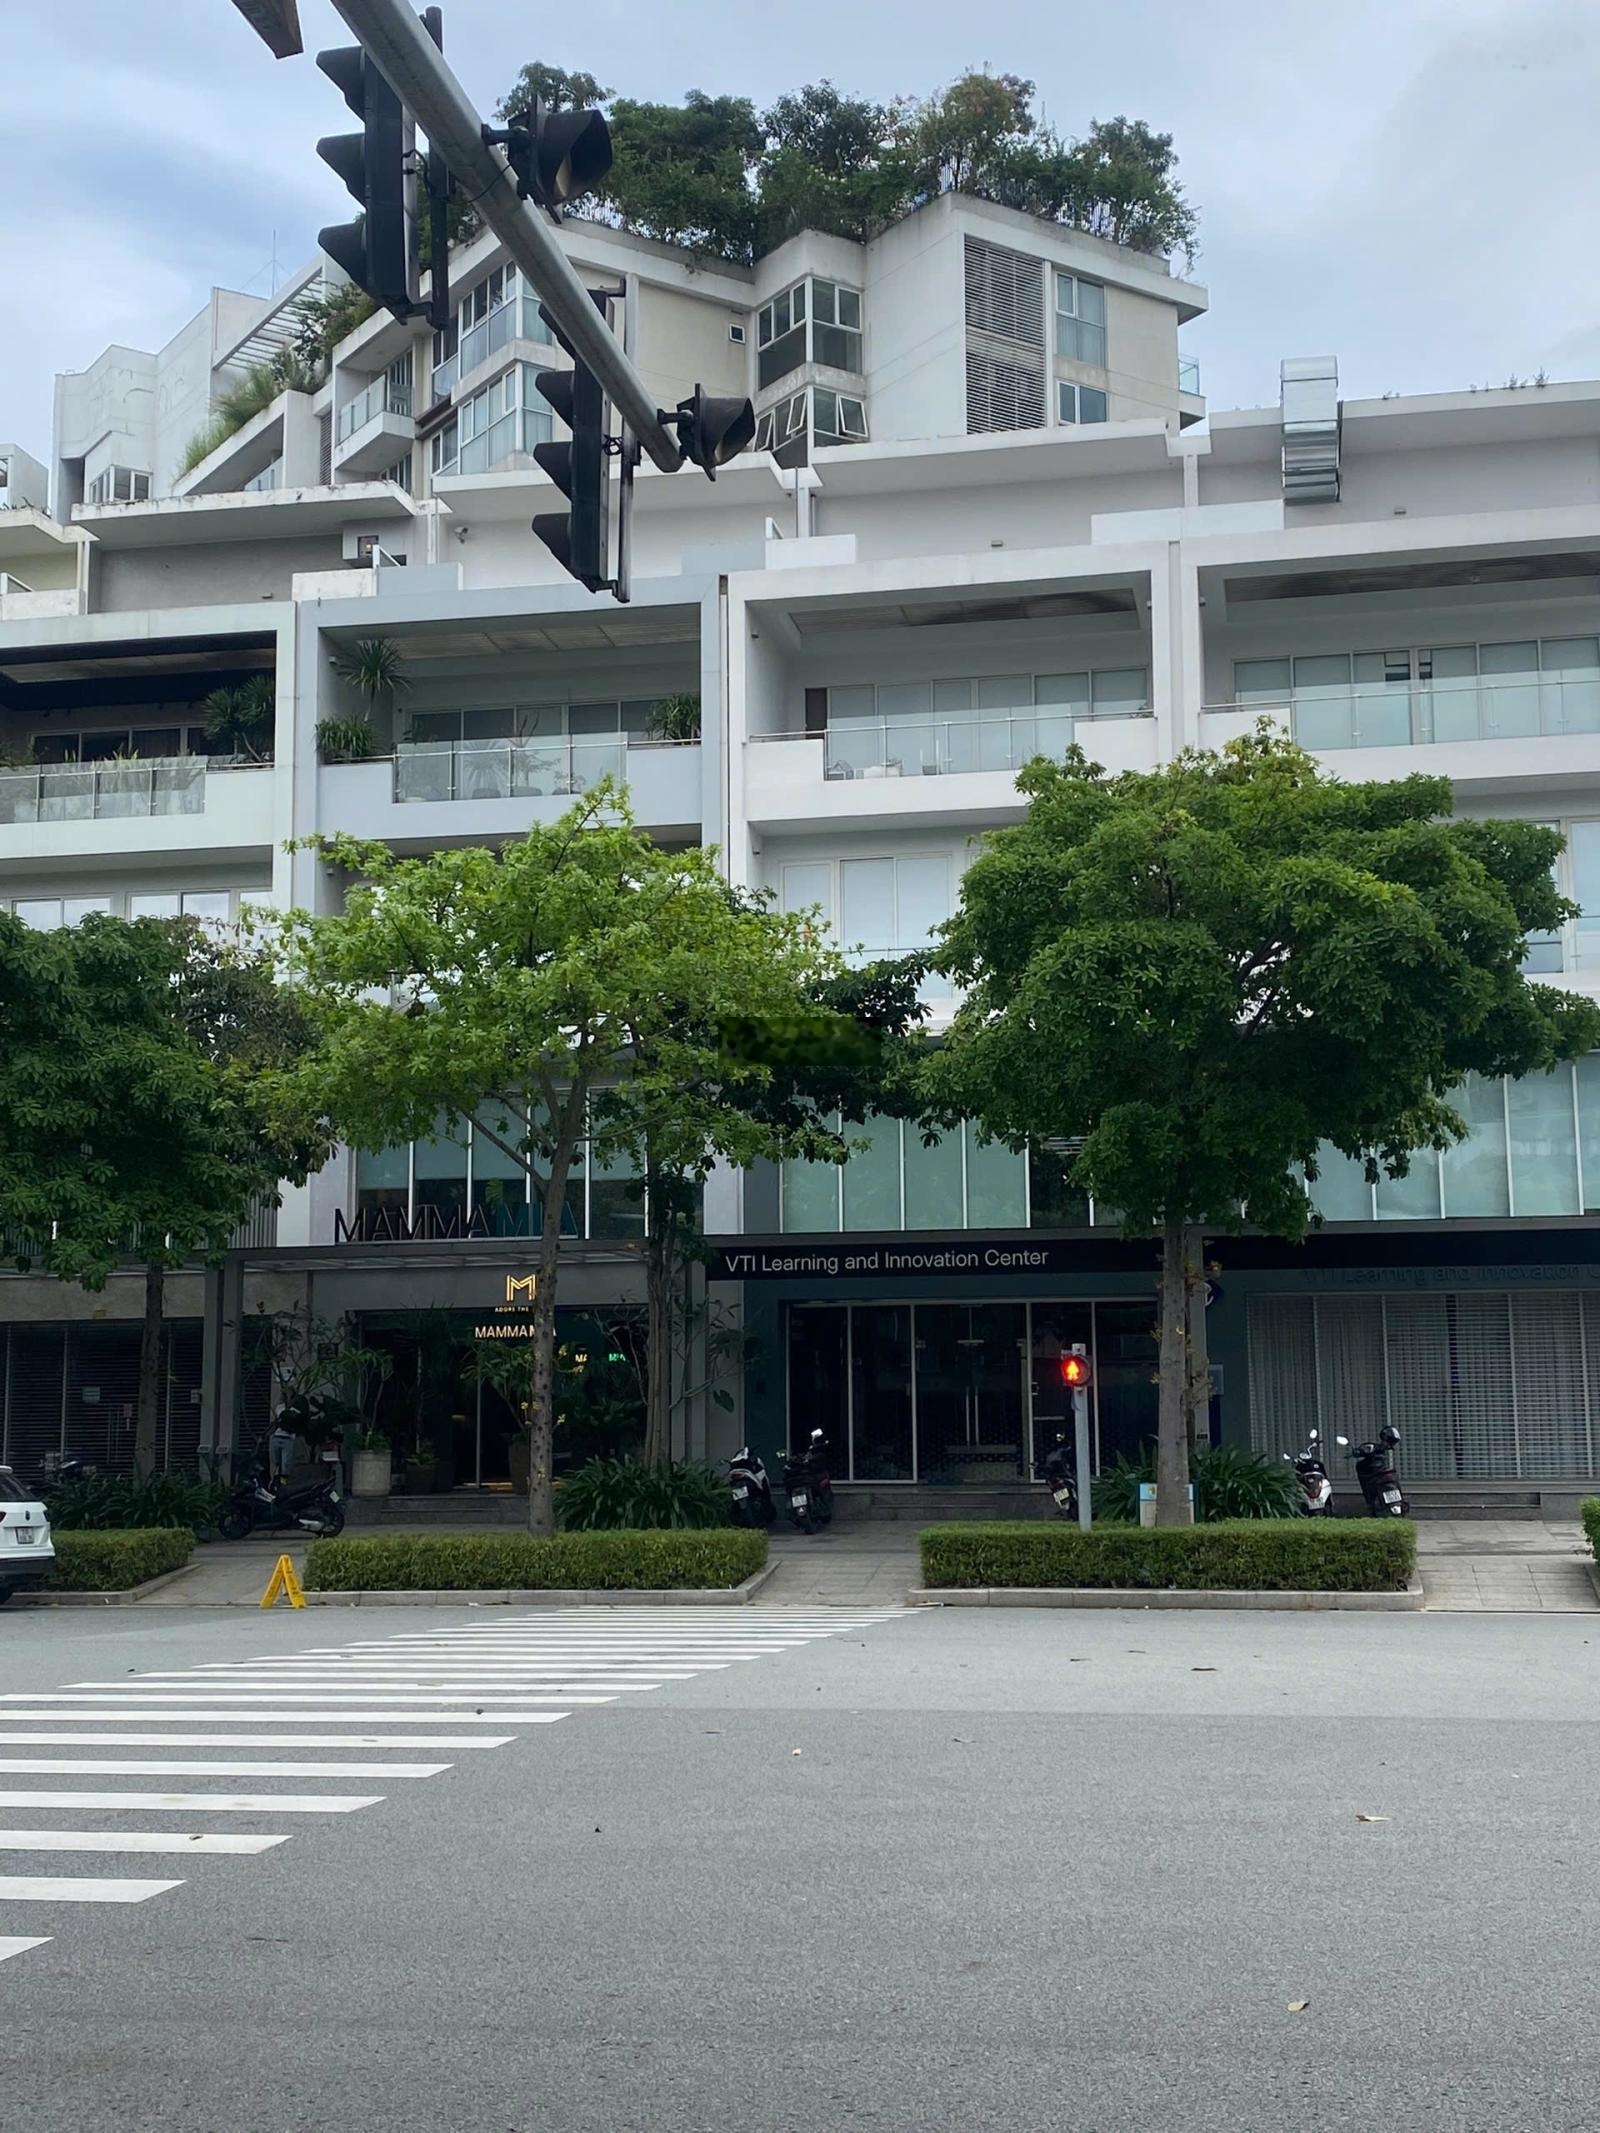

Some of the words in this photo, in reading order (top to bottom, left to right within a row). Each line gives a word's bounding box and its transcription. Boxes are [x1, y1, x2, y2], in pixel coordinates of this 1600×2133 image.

[334, 1203, 490, 1242] MAMMA
[725, 1255, 756, 1272] VTI
[762, 1253, 839, 1275] Learning
[845, 1251, 878, 1270] and
[885, 1249, 979, 1269] Innovation
[985, 1248, 1049, 1267] Center
[474, 1325, 528, 1338] MAMMA
